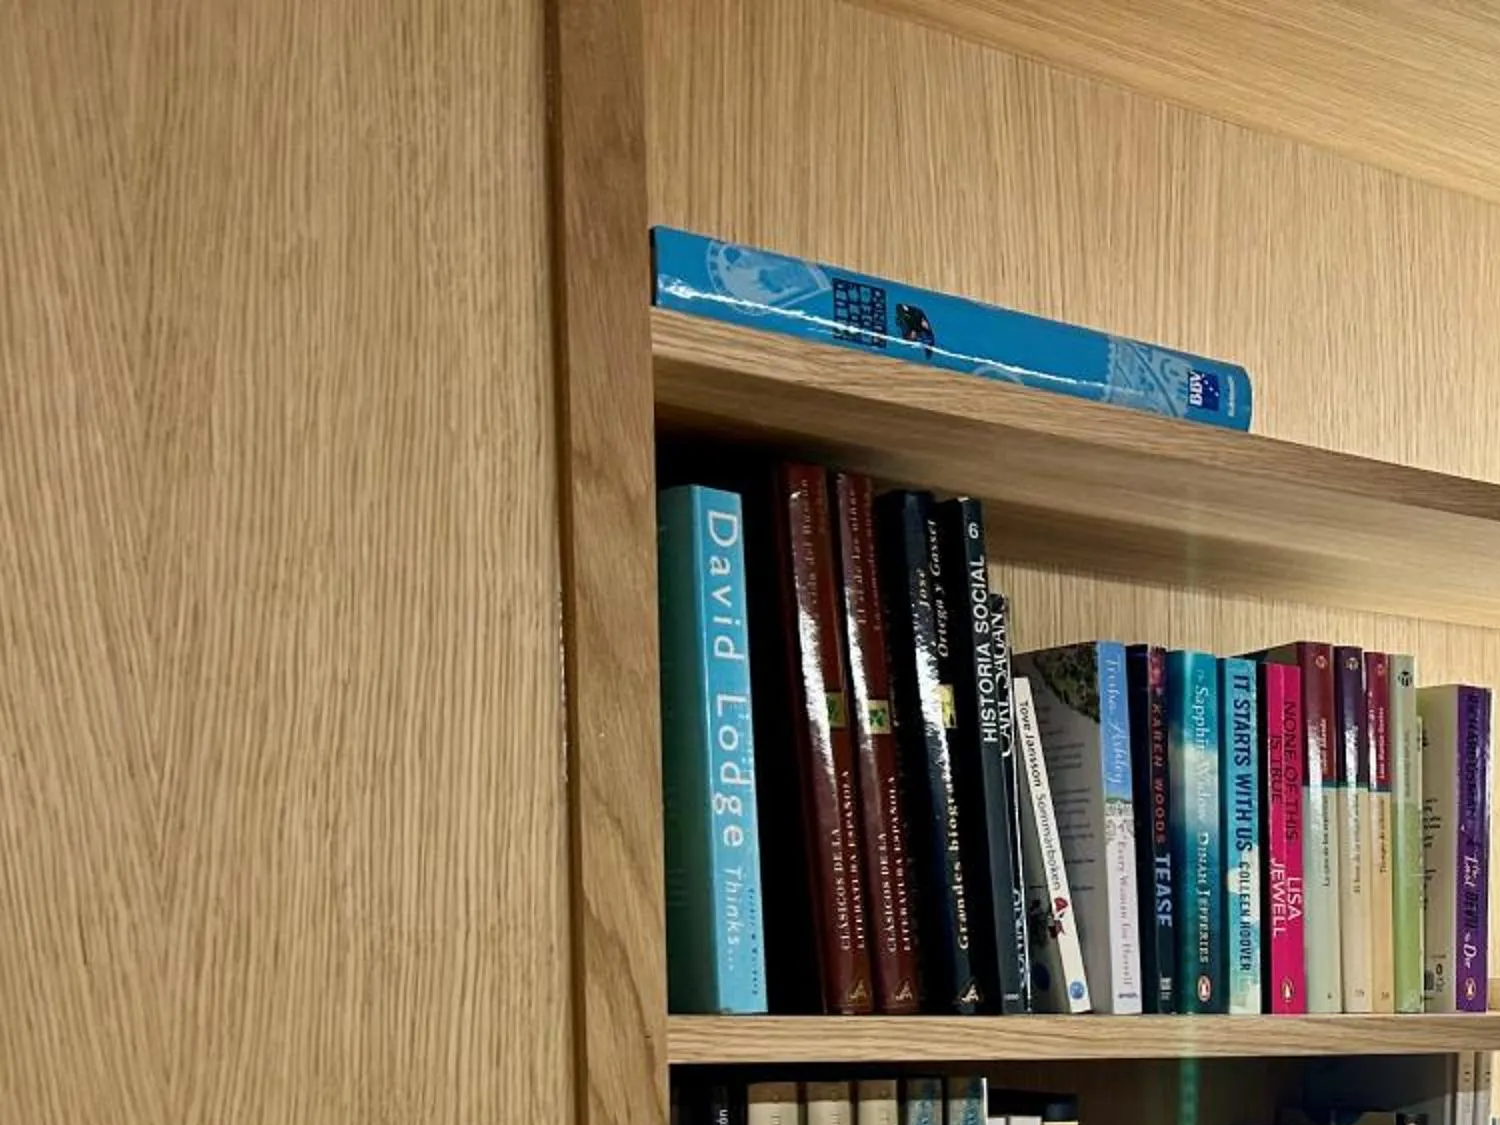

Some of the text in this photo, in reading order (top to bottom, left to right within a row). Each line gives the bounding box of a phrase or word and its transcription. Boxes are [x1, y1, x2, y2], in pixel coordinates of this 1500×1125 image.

[917, 568, 930, 609] José
[927, 520, 949, 657] Ortega y Gasset
[967, 522, 980, 539] 6
[706, 510, 747, 848] David Lodge
[969, 554, 997, 742] HISTORIA SOCIAL
[1019, 699, 1062, 892] Tove Jansson Sommarboken
[1152, 704, 1166, 843] KAREN WOODS
[1233, 674, 1252, 852] IT STARTS WITH US
[1270, 734, 1283, 805] IS TRUE
[1283, 701, 1300, 841] NONE OF THIS
[831, 828, 850, 951] CLÁSICOS DE LA
[877, 832, 897, 952] CLÁSICOS DE LA
[952, 861, 969, 950] Grandes
[1155, 853, 1172, 928] TEASE
[1239, 861, 1252, 971] COLLEEN HOOVER
[1271, 857, 1287, 938] JEWELL
[1287, 876, 1302, 921] LISA
